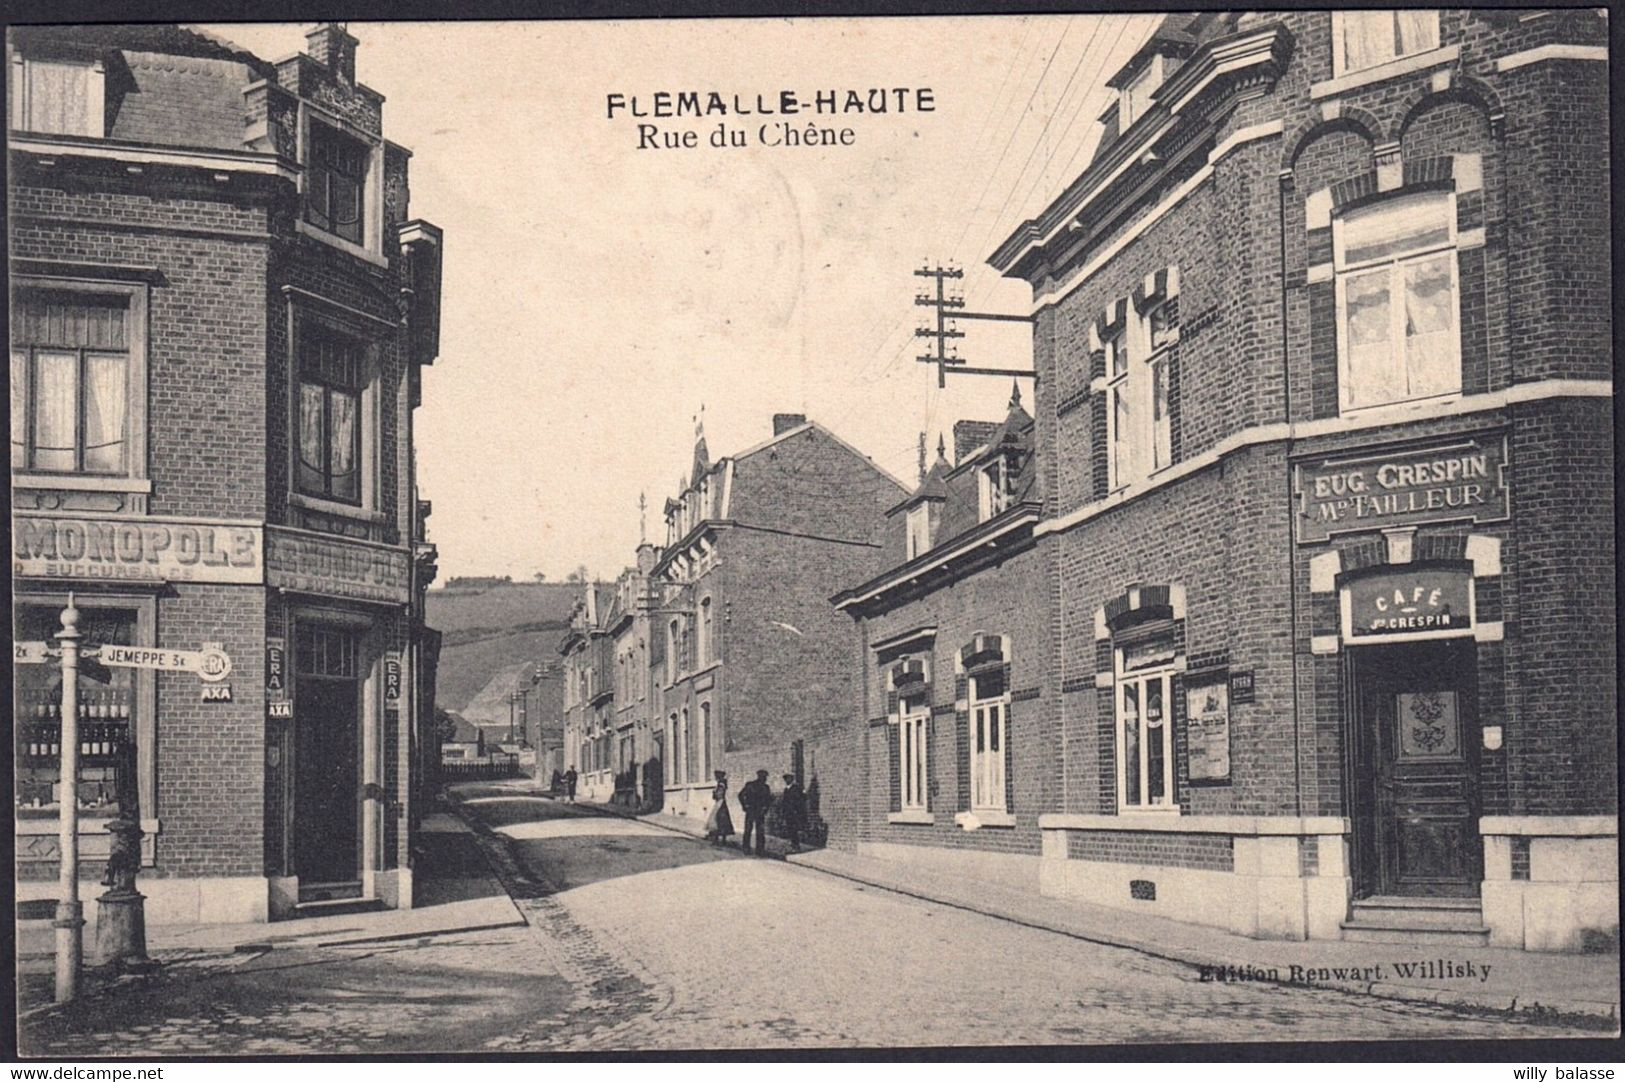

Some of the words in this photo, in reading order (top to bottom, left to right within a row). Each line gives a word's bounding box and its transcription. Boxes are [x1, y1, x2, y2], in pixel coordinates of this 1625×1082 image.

[1315, 472, 1370, 498] EUG.
[1350, 484, 1486, 519] TAILLEUR
[15, 518, 256, 568] MONOPOLE
[46, 562, 194, 580] SUCCURSALES
[1375, 586, 1443, 612] CAFÉ
[1389, 614, 1451, 629] CRESPIN
[108, 649, 166, 666] JEMEPPE
[268, 649, 281, 688] ERA
[201, 687, 231, 699] AXA
[387, 662, 399, 698] ERA
[268, 705, 290, 716] AXA
